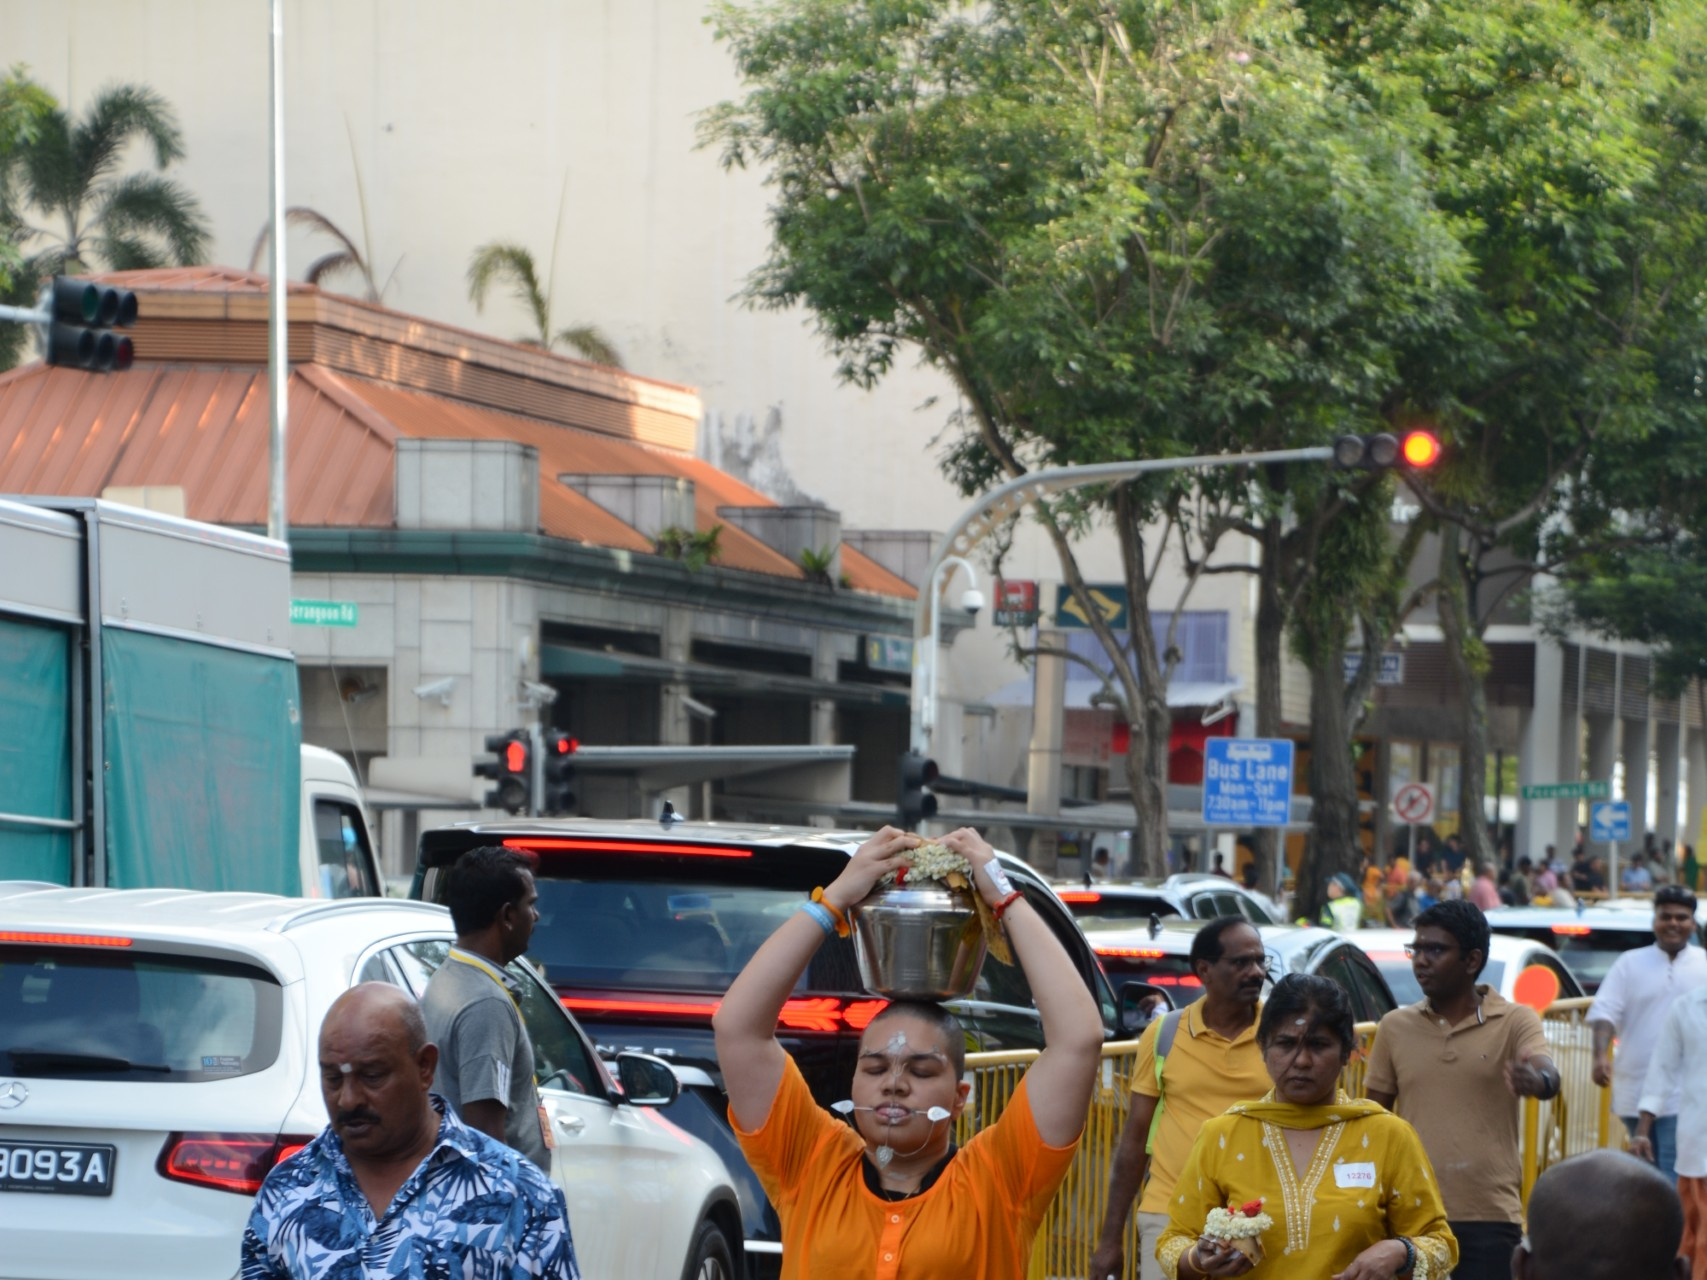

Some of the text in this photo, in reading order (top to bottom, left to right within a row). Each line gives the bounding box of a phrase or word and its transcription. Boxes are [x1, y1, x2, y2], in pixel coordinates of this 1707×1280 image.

[341, 603, 354, 621] Rd
[1207, 758, 1288, 781] Bus Lane
